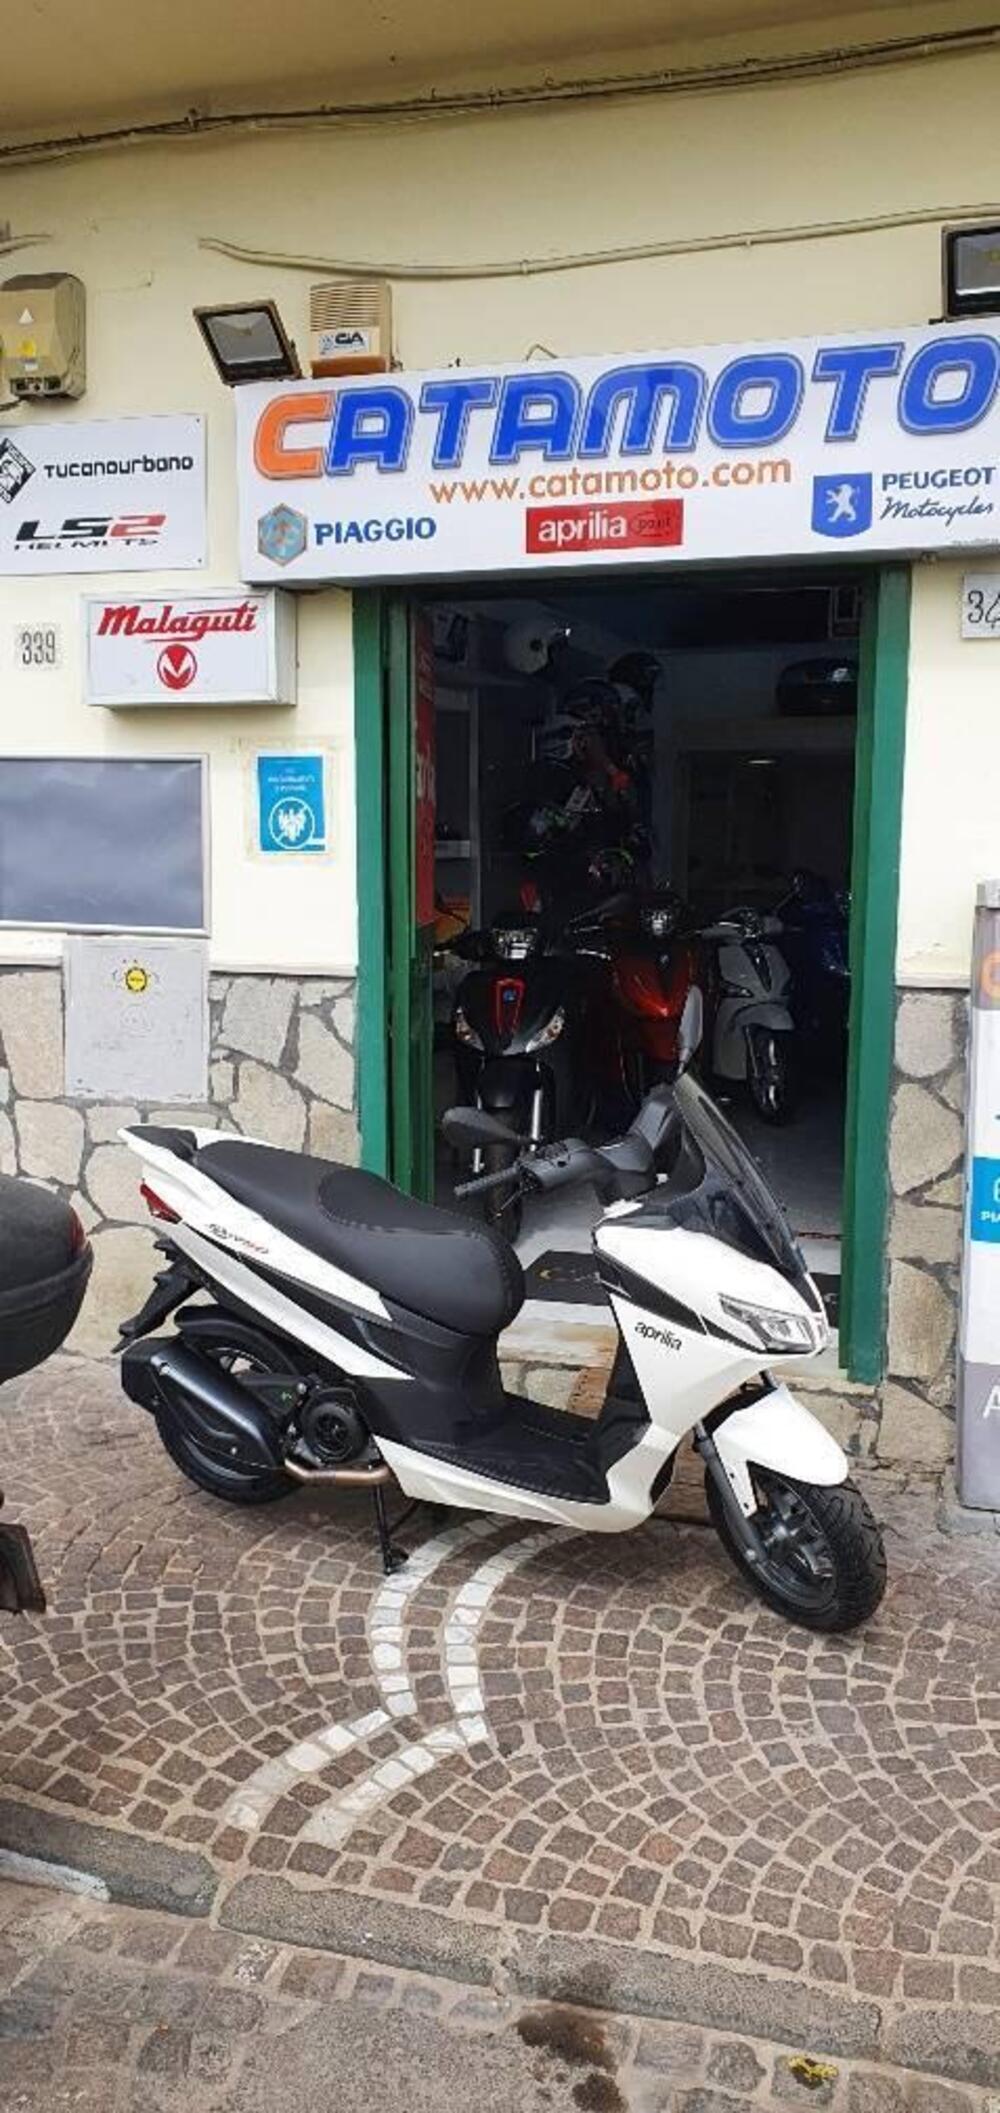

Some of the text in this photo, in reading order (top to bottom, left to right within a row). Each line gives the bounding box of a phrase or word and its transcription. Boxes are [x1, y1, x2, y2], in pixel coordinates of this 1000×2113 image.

[253, 334, 1000, 481] CATAMOTO
[430, 458, 791, 504] www.catamoto.com
[882, 466, 997, 491] PEUGEOT
[16, 514, 166, 541] LS2
[314, 517, 437, 546] PIAGGIO
[538, 509, 628, 547] aprilia
[96, 601, 259, 643] Malaguti
[22, 632, 56, 665] 339
[635, 1322, 682, 1350] aprilia
